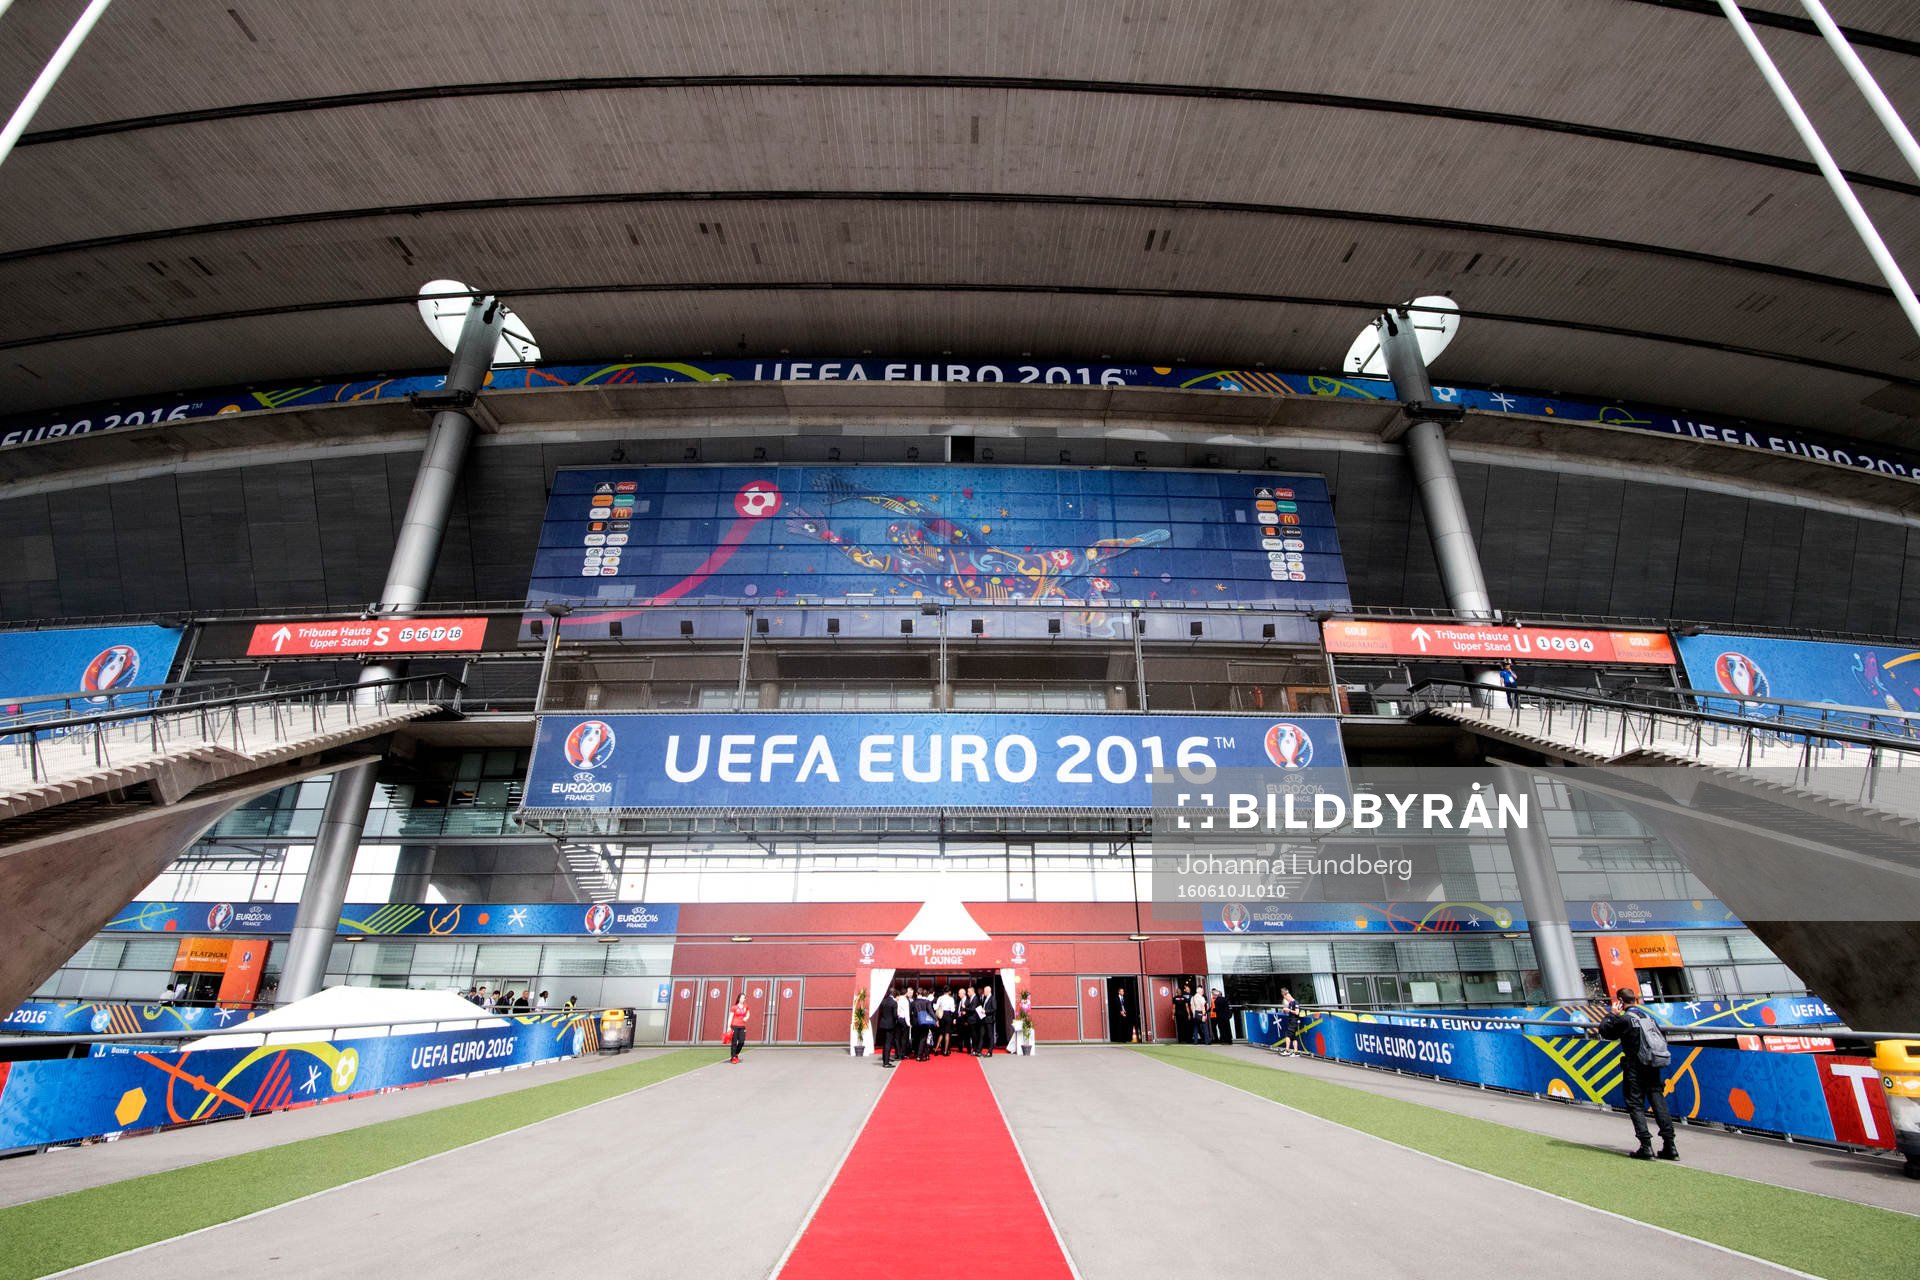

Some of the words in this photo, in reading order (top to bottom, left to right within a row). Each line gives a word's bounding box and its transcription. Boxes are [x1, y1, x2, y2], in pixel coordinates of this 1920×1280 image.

[885, 364, 1004, 382] EURO
[1018, 366, 1126, 385] 2016
[299, 628, 338, 638] Tribune
[340, 627, 372, 636] Haute
[373, 627, 390, 646] S
[401, 630, 413, 640] 15
[417, 630, 429, 639] 16
[433, 629, 445, 639] 17
[450, 629, 462, 638] 18
[1435, 630, 1475, 640] Tribune
[1478, 631, 1509, 641] Haute
[309, 638, 339, 649] Upper
[341, 637, 370, 647] Stand
[1453, 642, 1481, 652] Upper
[1484, 642, 1512, 652] Stand
[1513, 634, 1531, 652] U
[665, 735, 841, 783] UEFA
[859, 734, 1038, 784] EURO
[1056, 735, 1218, 784] 2016
[190, 950, 228, 959] PLATINUM
[910, 944, 932, 956] VIP
[932, 947, 977, 956] HONORARY
[924, 956, 963, 965] LOUNGE
[13, 1009, 48, 1023] 2016
[1791, 1003, 1824, 1017] UEFA
[411, 1044, 448, 1069] UEFA
[451, 1040, 485, 1064] EURO
[485, 1037, 514, 1059] 2016
[1355, 1033, 1384, 1055] UEFA
[1384, 1036, 1416, 1059] EURO
[1418, 1040, 1452, 1065] 2016
[1830, 1063, 1881, 1140] T
